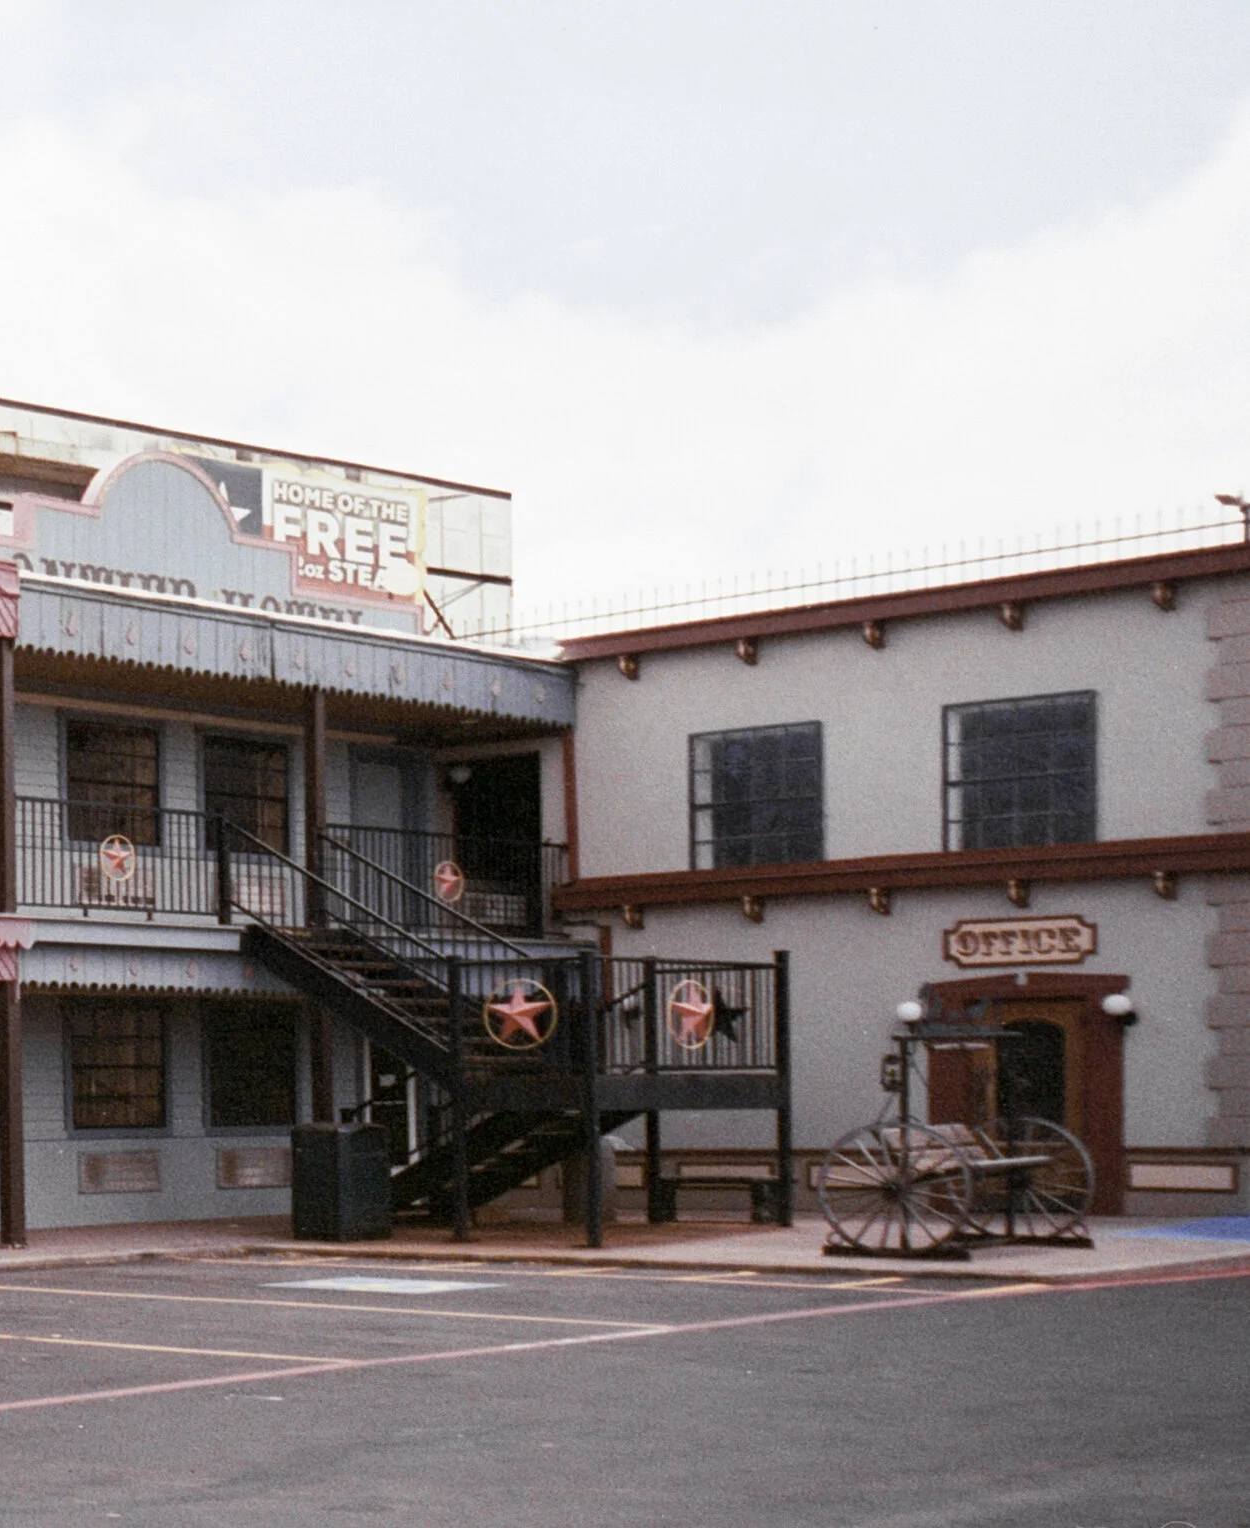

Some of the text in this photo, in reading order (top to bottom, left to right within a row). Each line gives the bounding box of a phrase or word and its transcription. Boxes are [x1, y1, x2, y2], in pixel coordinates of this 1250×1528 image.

[273, 480, 409, 522] HOME OF THE
[273, 502, 408, 567] FREE
[328, 559, 388, 591] STEA
[955, 926, 1082, 957] OFFICE
